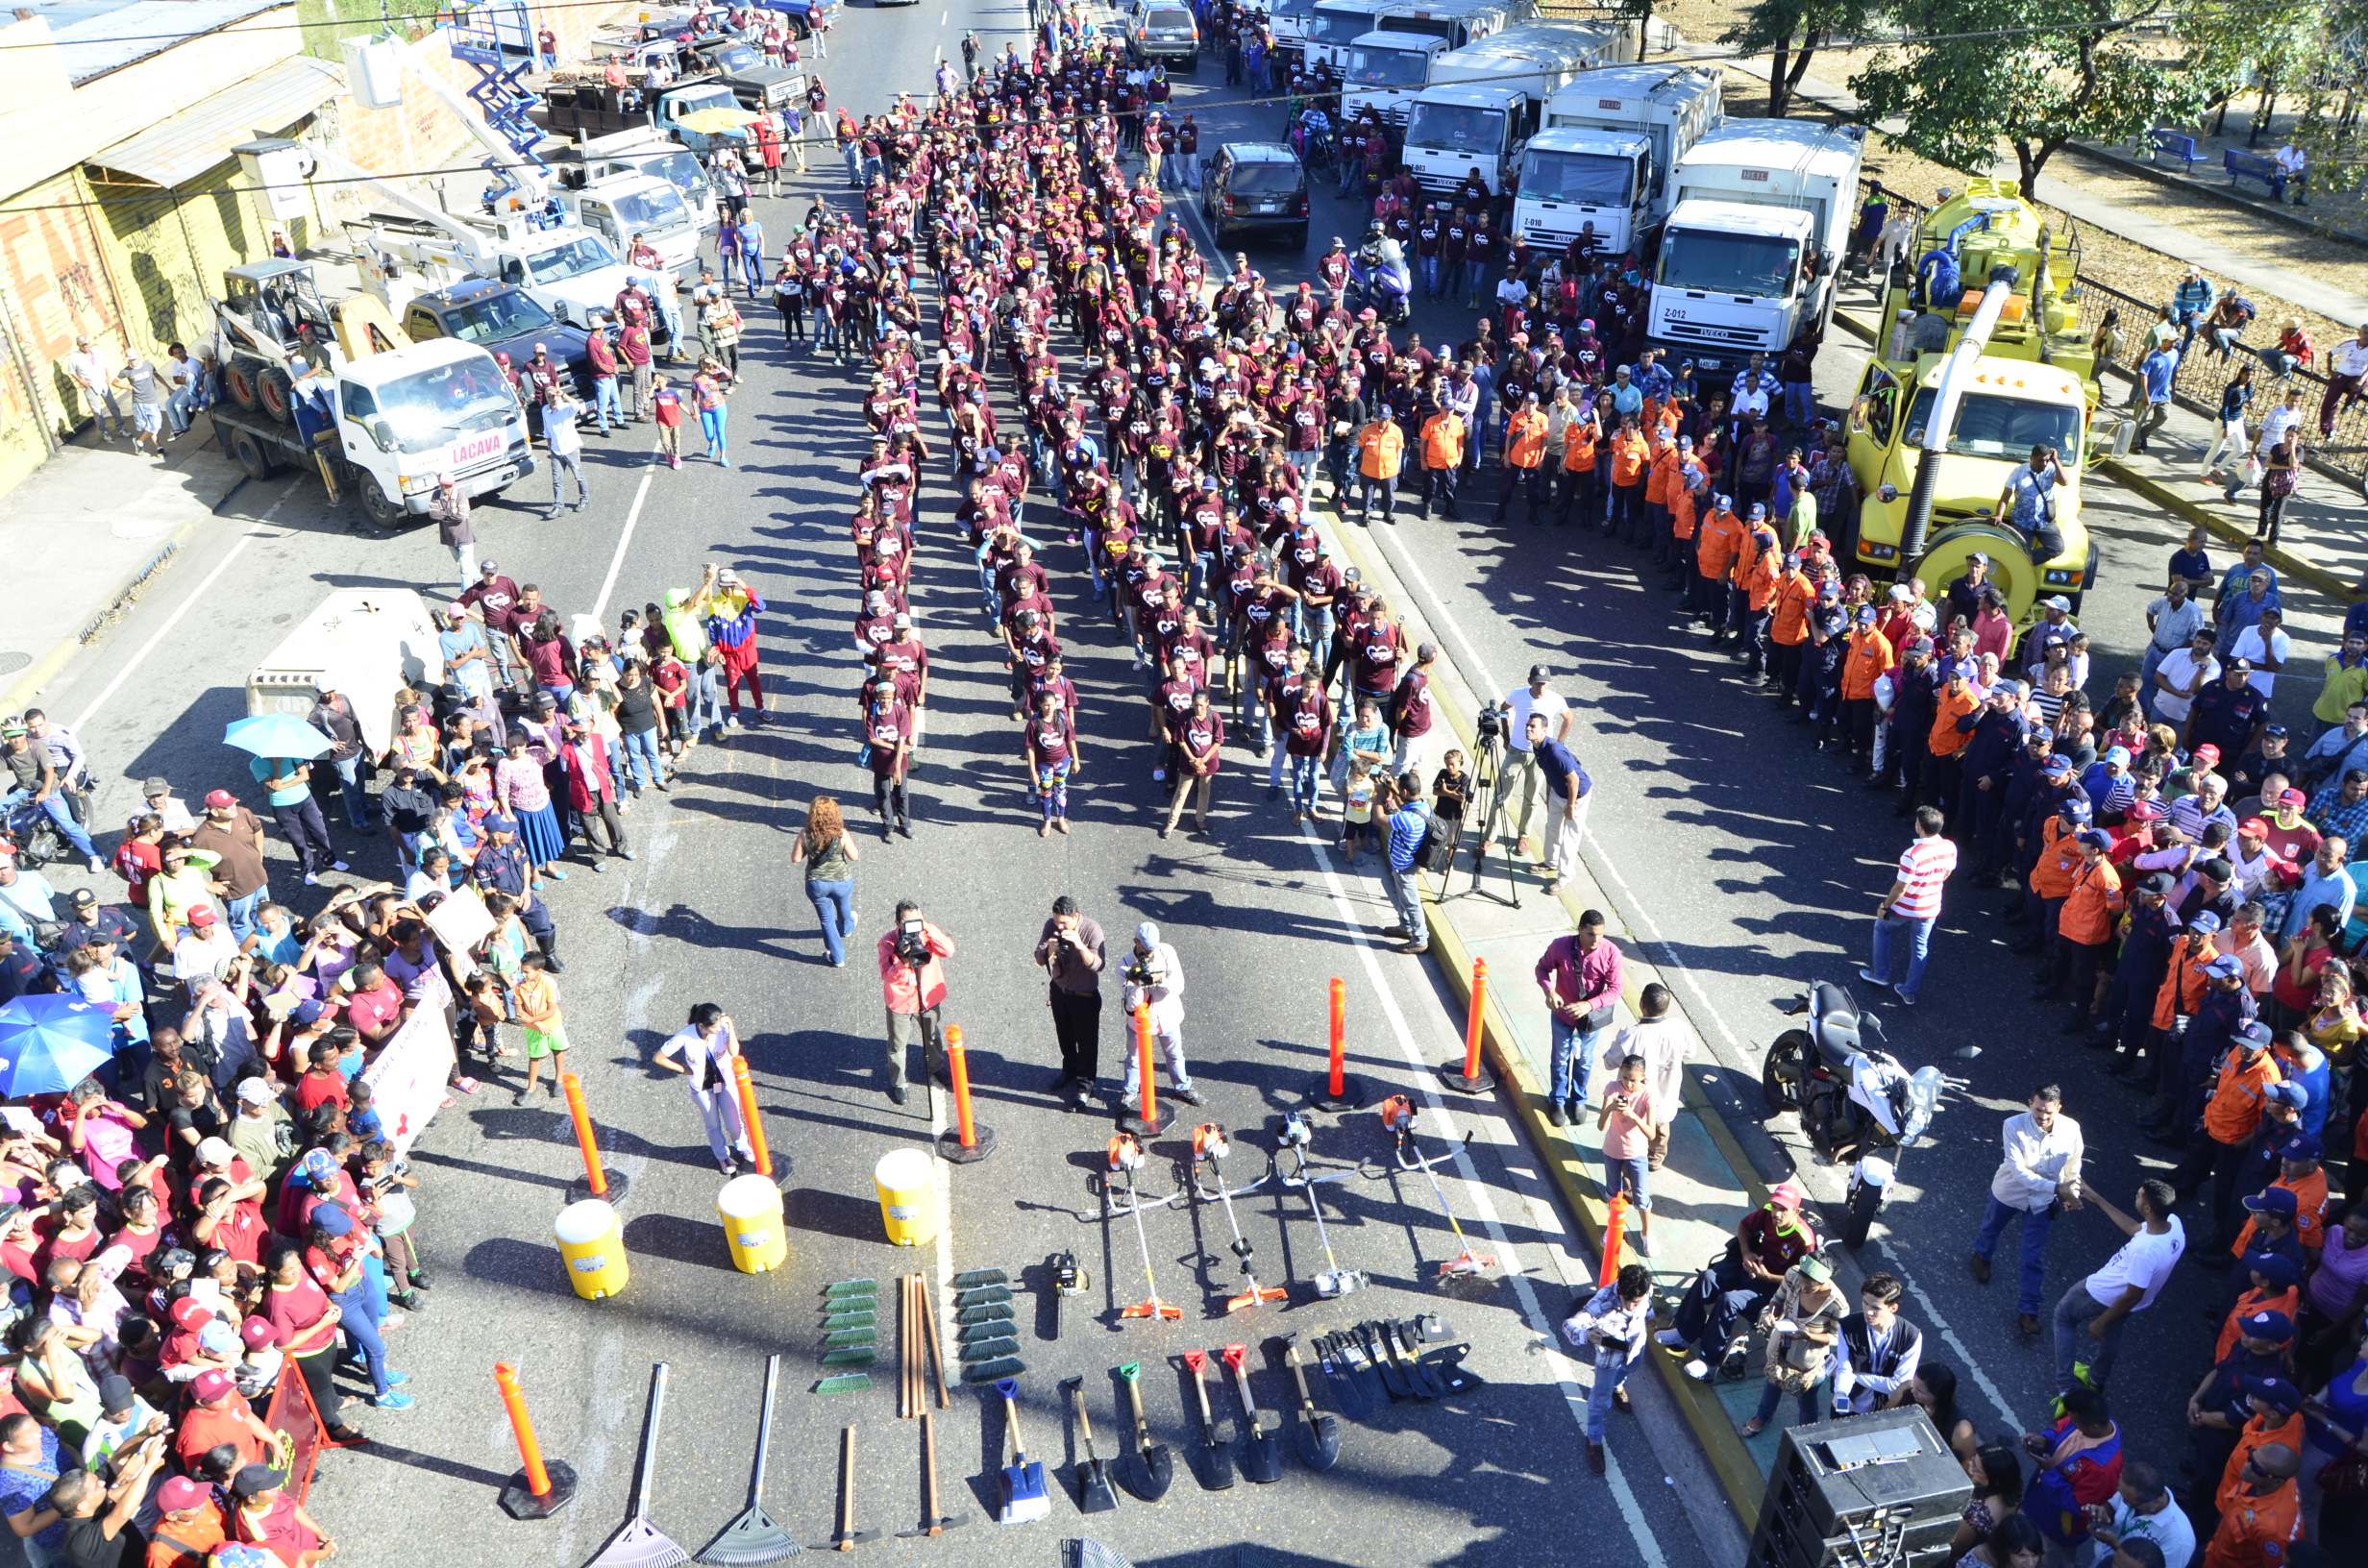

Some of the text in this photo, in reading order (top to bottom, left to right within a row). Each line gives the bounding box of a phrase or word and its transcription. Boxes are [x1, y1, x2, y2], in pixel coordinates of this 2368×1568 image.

[1743, 171, 1766, 181] HEIL
[1524, 218, 1542, 228] Z-010
[1665, 307, 1687, 319] Z-012
[1700, 328, 1729, 338] IVECO
[453, 434, 501, 464] LACAVA
